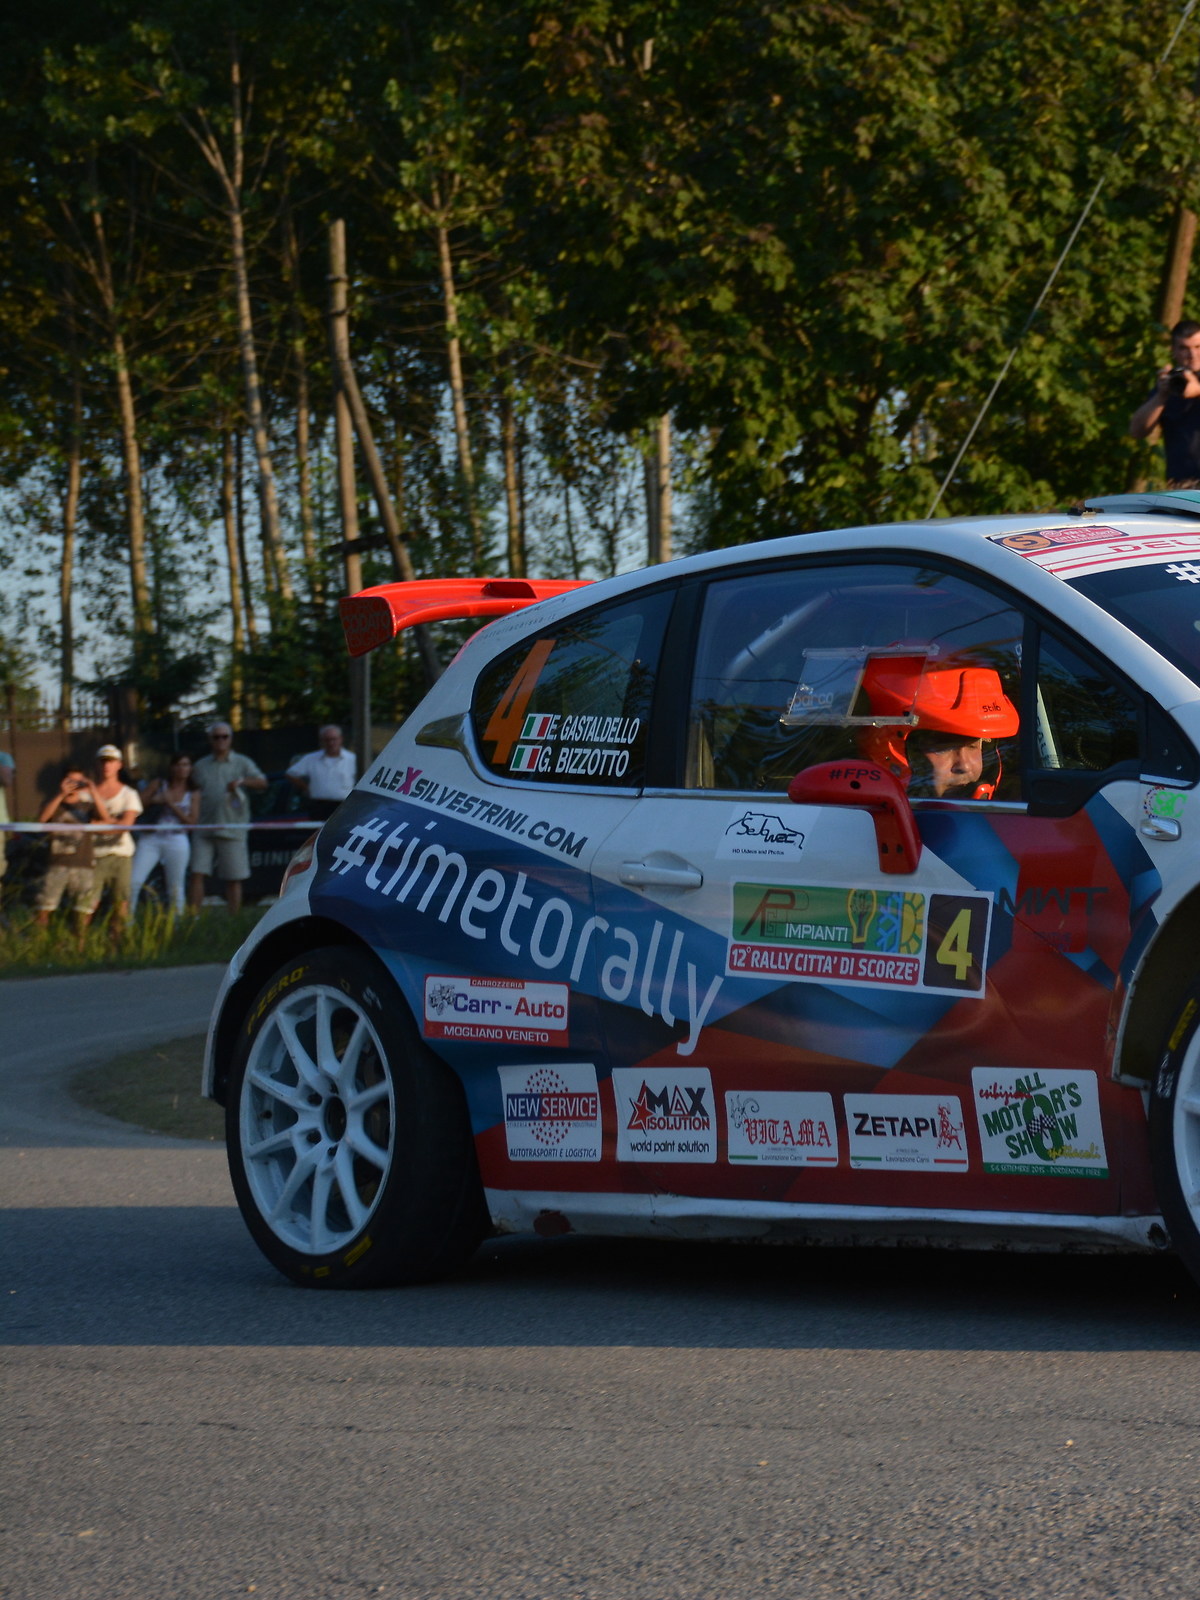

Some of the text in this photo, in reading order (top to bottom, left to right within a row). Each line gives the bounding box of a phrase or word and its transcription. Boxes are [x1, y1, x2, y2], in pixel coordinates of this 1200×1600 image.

[484, 639, 556, 764] 4
[560, 714, 640, 745] GASTALDELLO
[538, 746, 630, 777] G. BIZZOTTO
[829, 768, 881, 781] #FPS
[999, 886, 1109, 916] MWT
[329, 817, 724, 1056] #timetorally
[785, 922, 848, 942] IMPIANTI
[936, 908, 972, 980] 4
[751, 949, 791, 971] RALLY
[794, 953, 837, 975] CITTA'
[839, 957, 854, 976] DI
[471, 979, 524, 989] CARROZZERIA
[453, 993, 501, 1014] Carr
[514, 997, 565, 1019] Auto
[444, 1025, 549, 1043] MOGLIANO VENETO
[1015, 1072, 1046, 1094] ALL
[508, 1096, 596, 1118] NEW SERVICE
[636, 1082, 709, 1117] MAX
[853, 1113, 937, 1138] ZETAPI
[510, 1147, 558, 1158] AUTOTRASPORTI
[565, 1147, 597, 1158] LOGISTICA
[631, 1141, 709, 1155] world paint solution
